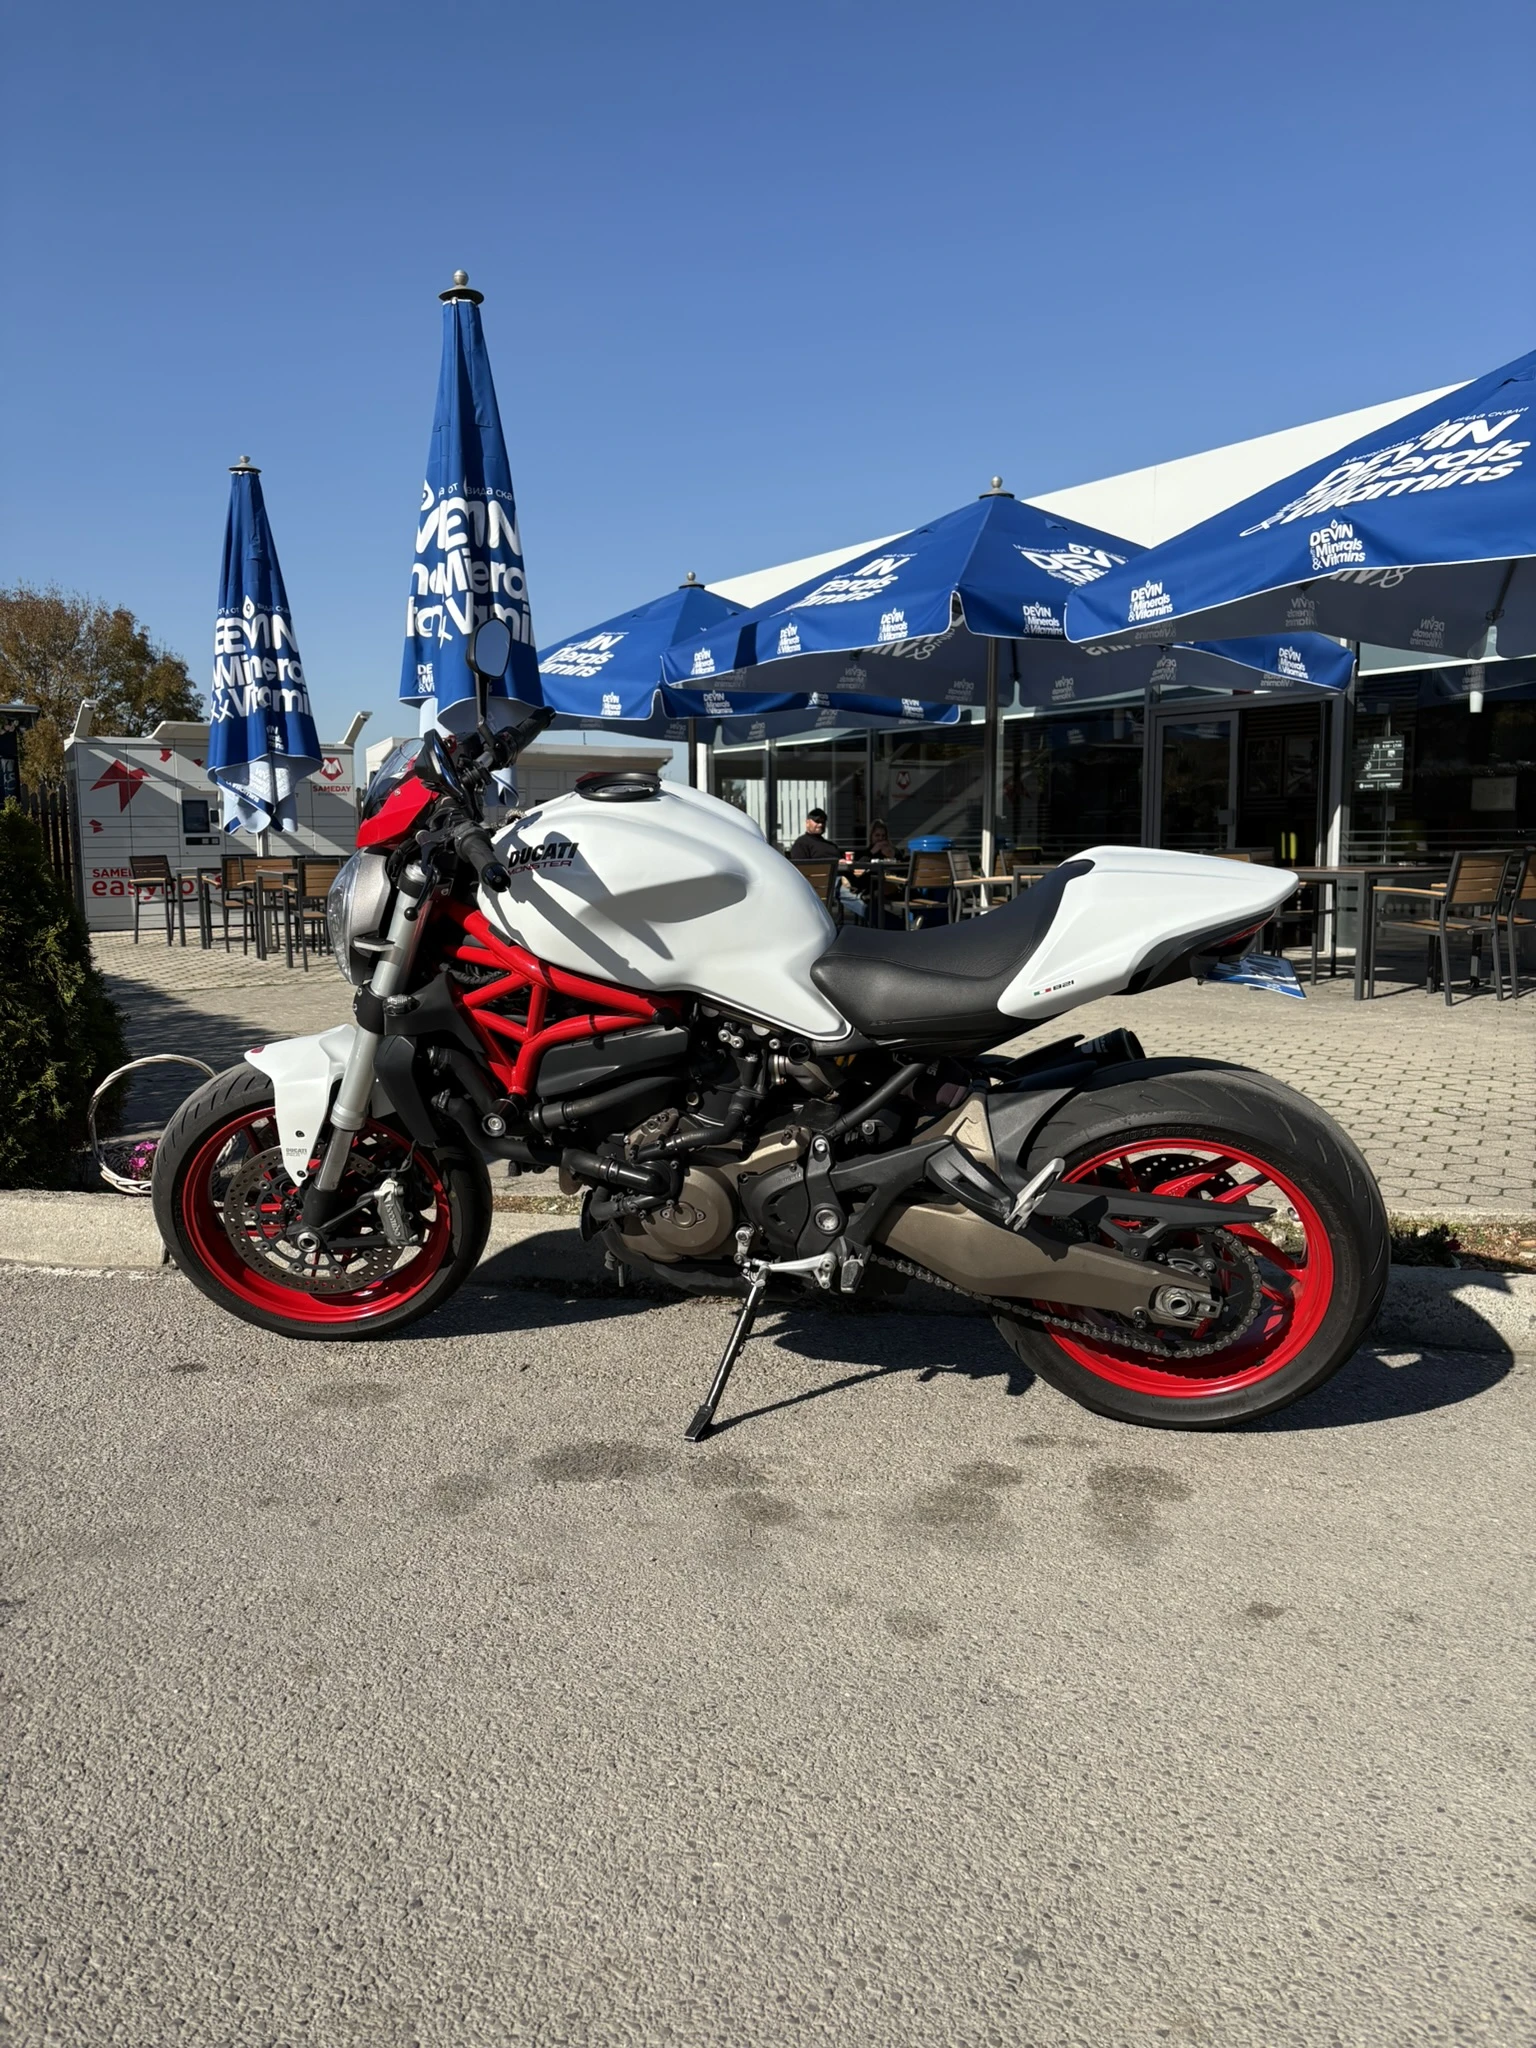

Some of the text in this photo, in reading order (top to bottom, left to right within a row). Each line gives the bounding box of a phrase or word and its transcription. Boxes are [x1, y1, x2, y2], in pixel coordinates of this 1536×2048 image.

[496, 489, 513, 500] ска
[1310, 524, 1353, 547] DEVIN
[1130, 582, 1163, 602] DEVIN
[1133, 593, 1170, 612] Minerals
[1022, 606, 1052, 618] DEVIN
[1027, 616, 1060, 627] Minerals
[508, 842, 580, 868] DUCATI
[508, 860, 572, 876] MONSTER
